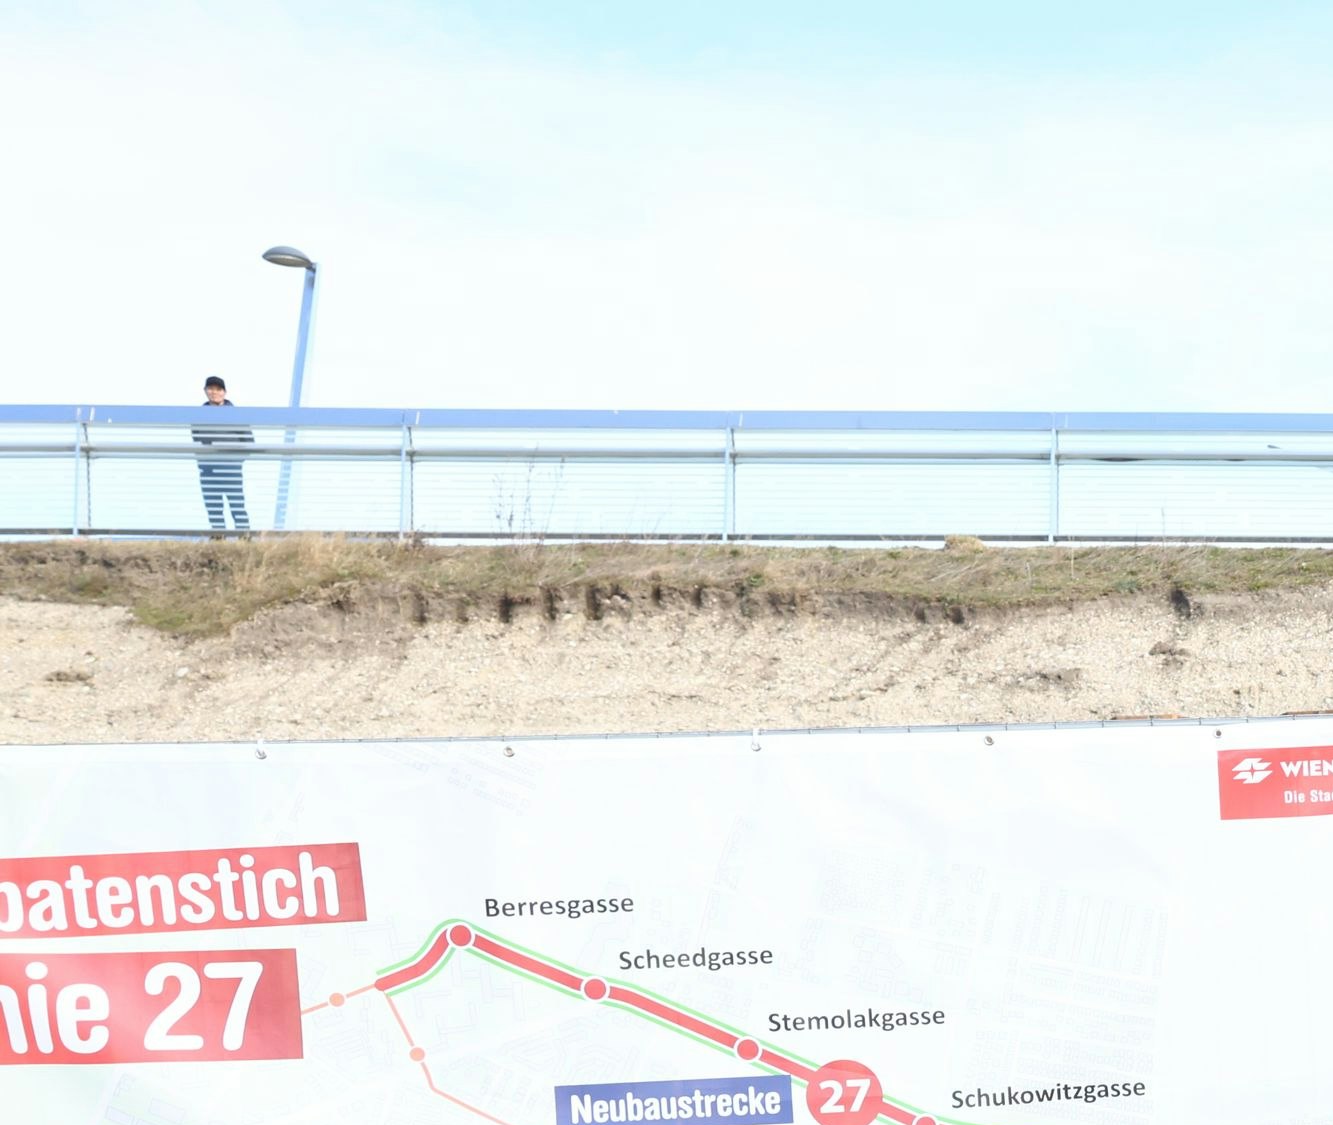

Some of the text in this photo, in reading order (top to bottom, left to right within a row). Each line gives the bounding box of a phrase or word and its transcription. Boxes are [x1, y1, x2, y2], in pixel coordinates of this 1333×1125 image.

[1284, 790, 1306, 804] Die
[484, 896, 634, 920] Berresgasse
[619, 946, 773, 972] Scheedgasse
[143, 961, 264, 1051] 27
[768, 1007, 945, 1033] Stemolakgasse
[570, 1086, 781, 1125] Neubaustrecke
[818, 1078, 871, 1114] 27
[951, 1078, 1146, 1109] Schukowitzgasse
